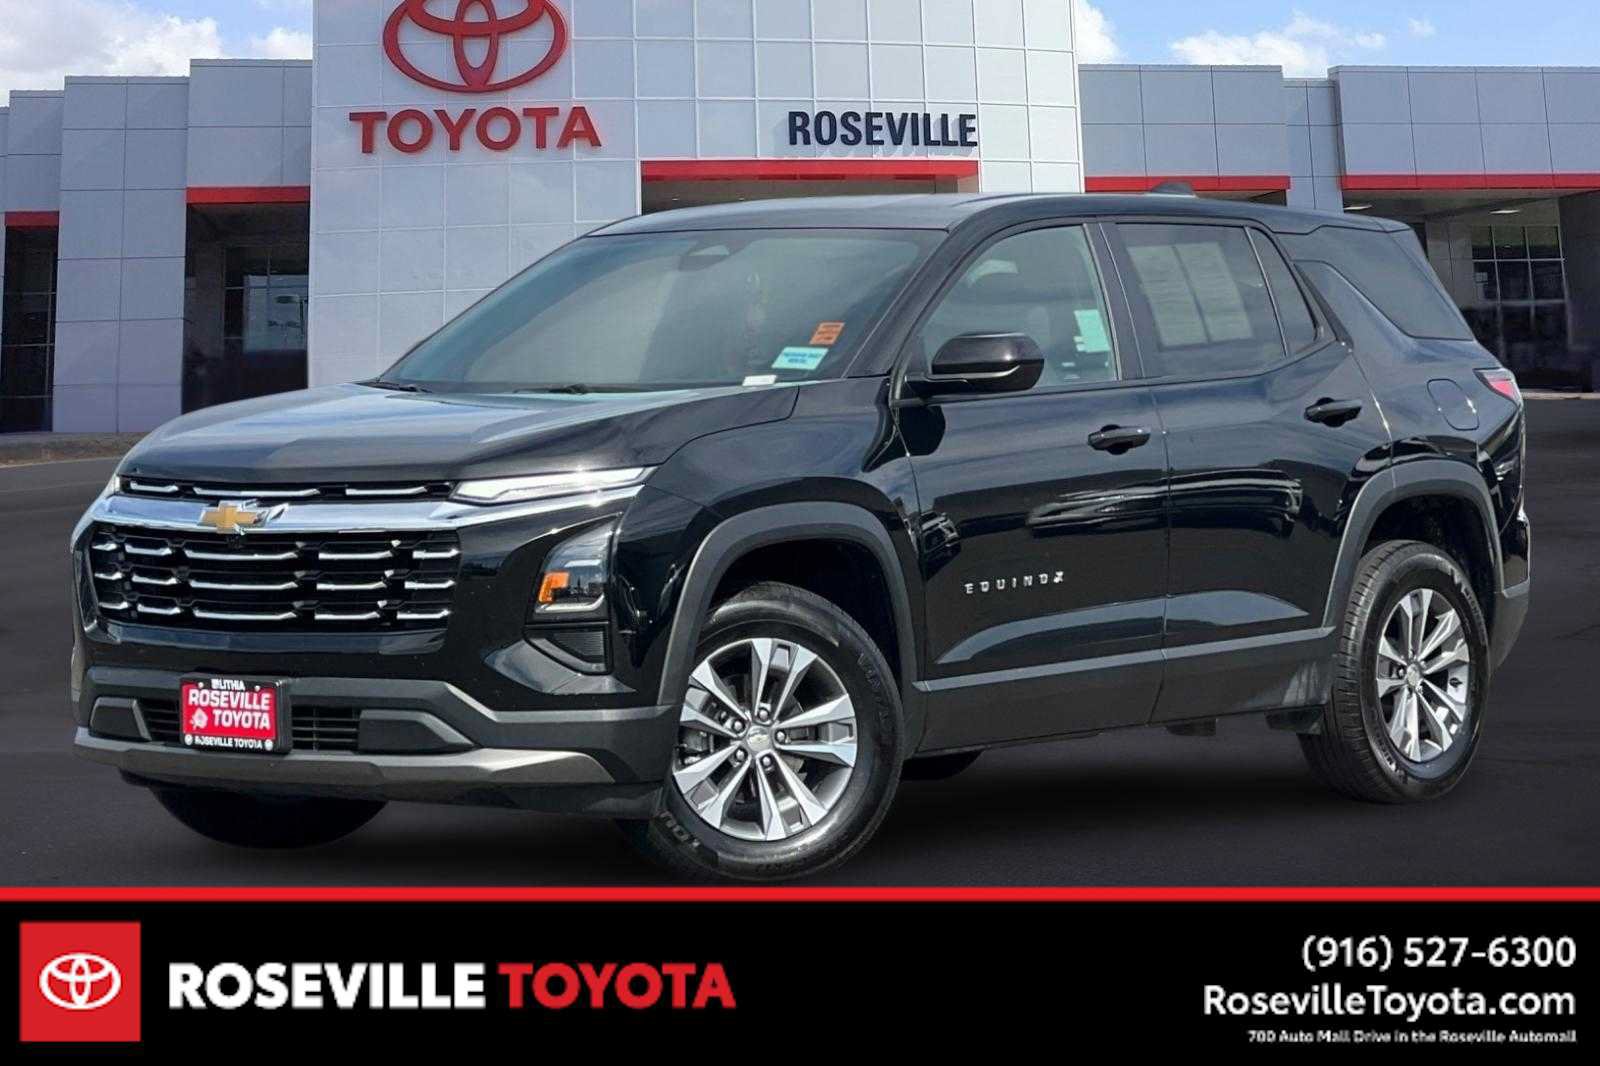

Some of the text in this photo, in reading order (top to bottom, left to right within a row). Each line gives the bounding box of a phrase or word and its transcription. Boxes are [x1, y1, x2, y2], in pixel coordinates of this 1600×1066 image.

[349, 106, 602, 153] TOYOTA
[788, 111, 978, 147] ROSEVILLE
[964, 571, 1064, 594] EQUINOX
[188, 689, 271, 710] ROSEVILLE
[212, 709, 271, 730] TOYOTA
[194, 736, 263, 749] ROSEVILLE TOYOTA
